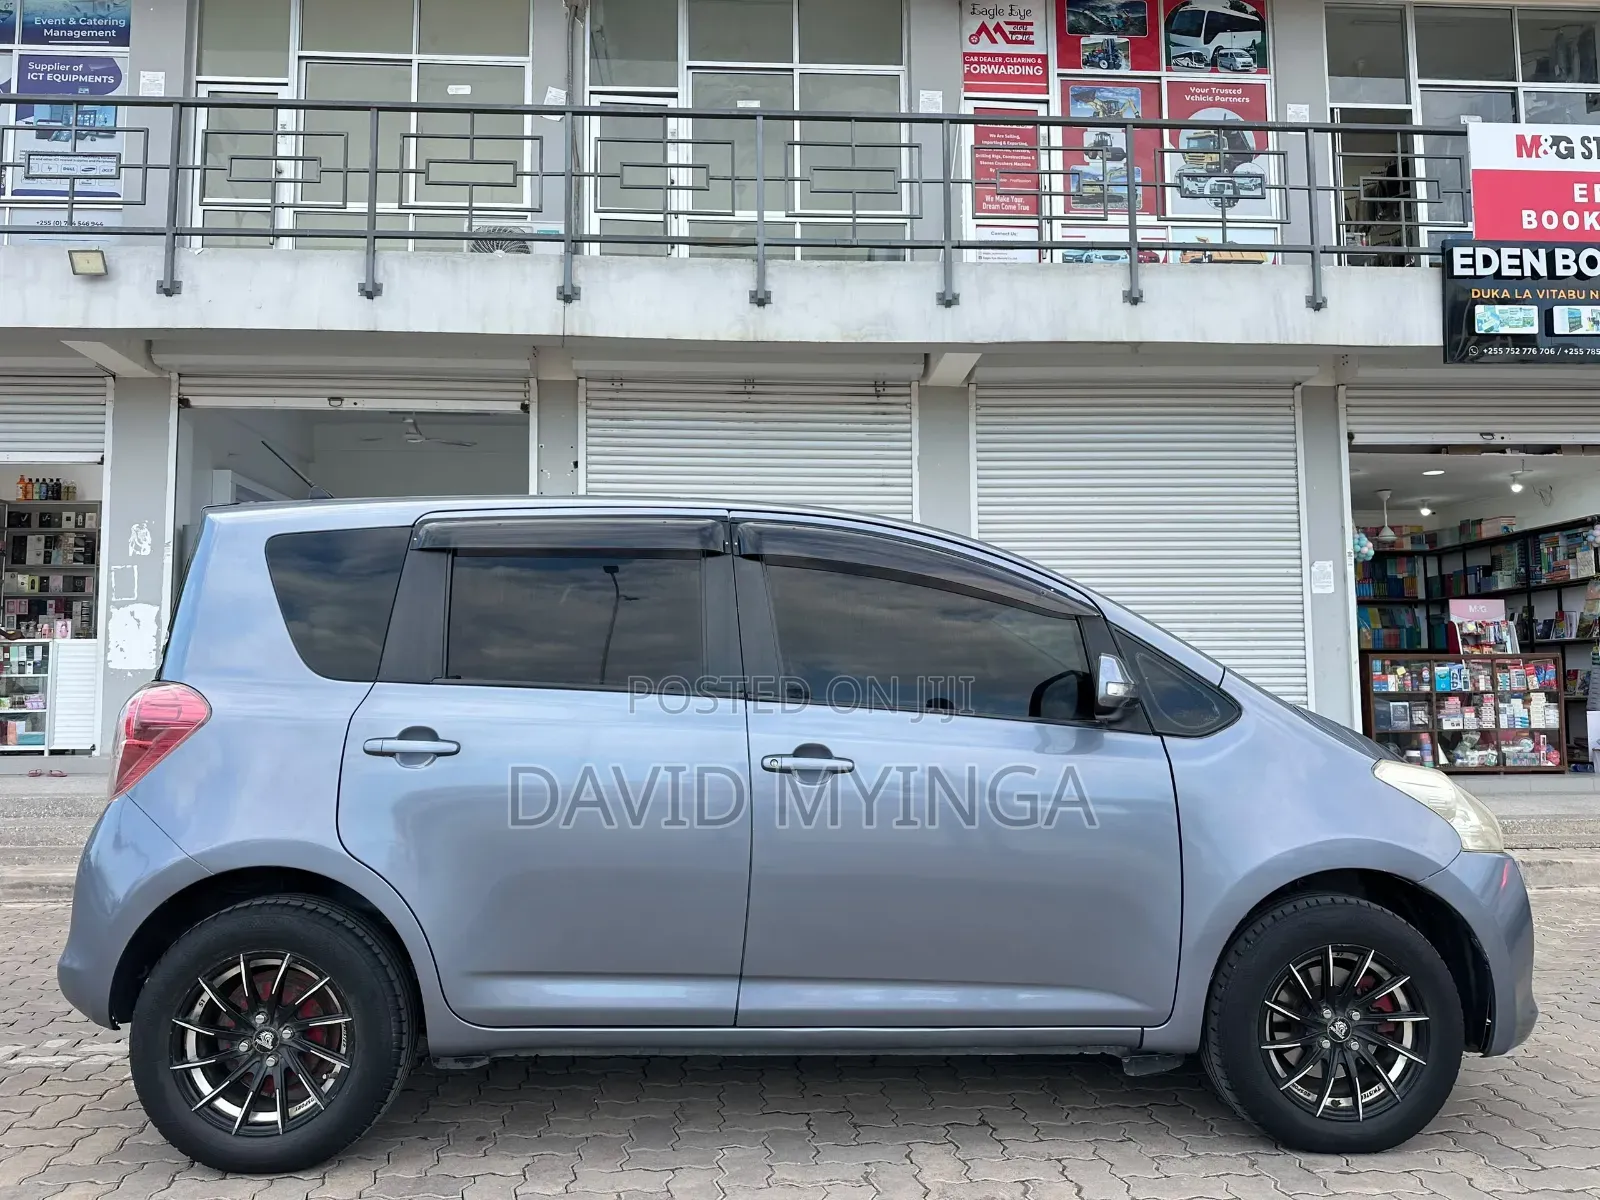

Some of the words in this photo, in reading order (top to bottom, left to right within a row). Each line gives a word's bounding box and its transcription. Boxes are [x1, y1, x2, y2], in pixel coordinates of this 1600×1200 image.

[970, 3, 1005, 19] Eagle
[1008, 4, 1032, 20] Eye
[34, 17, 66, 25] Event
[69, 17, 76, 25] &
[79, 17, 126, 27] Catering
[43, 28, 116, 38] Management
[28, 62, 70, 71] Supplier
[964, 64, 1043, 75] FORWARDING
[27, 72, 44, 80] ICT
[47, 73, 115, 83] EQUIPMENTS
[1190, 86, 1209, 94] Your
[1184, 94, 1213, 102] Vehicle
[1214, 95, 1250, 103] Partners
[1515, 134, 1575, 160] M&G
[982, 202, 1000, 210] Dream
[1017, 203, 1030, 211] True
[1521, 209, 1600, 231] BOOK
[1452, 246, 1548, 277] EDEN
[1554, 247, 1600, 277] BO
[1471, 288, 1511, 299] DUKA
[1515, 288, 1532, 299] LA
[1536, 288, 1586, 299] VITABU
[1483, 347, 1503, 355] +255
[1505, 347, 1520, 355] 752
[1522, 347, 1537, 355] 776
[1539, 347, 1555, 355] 706
